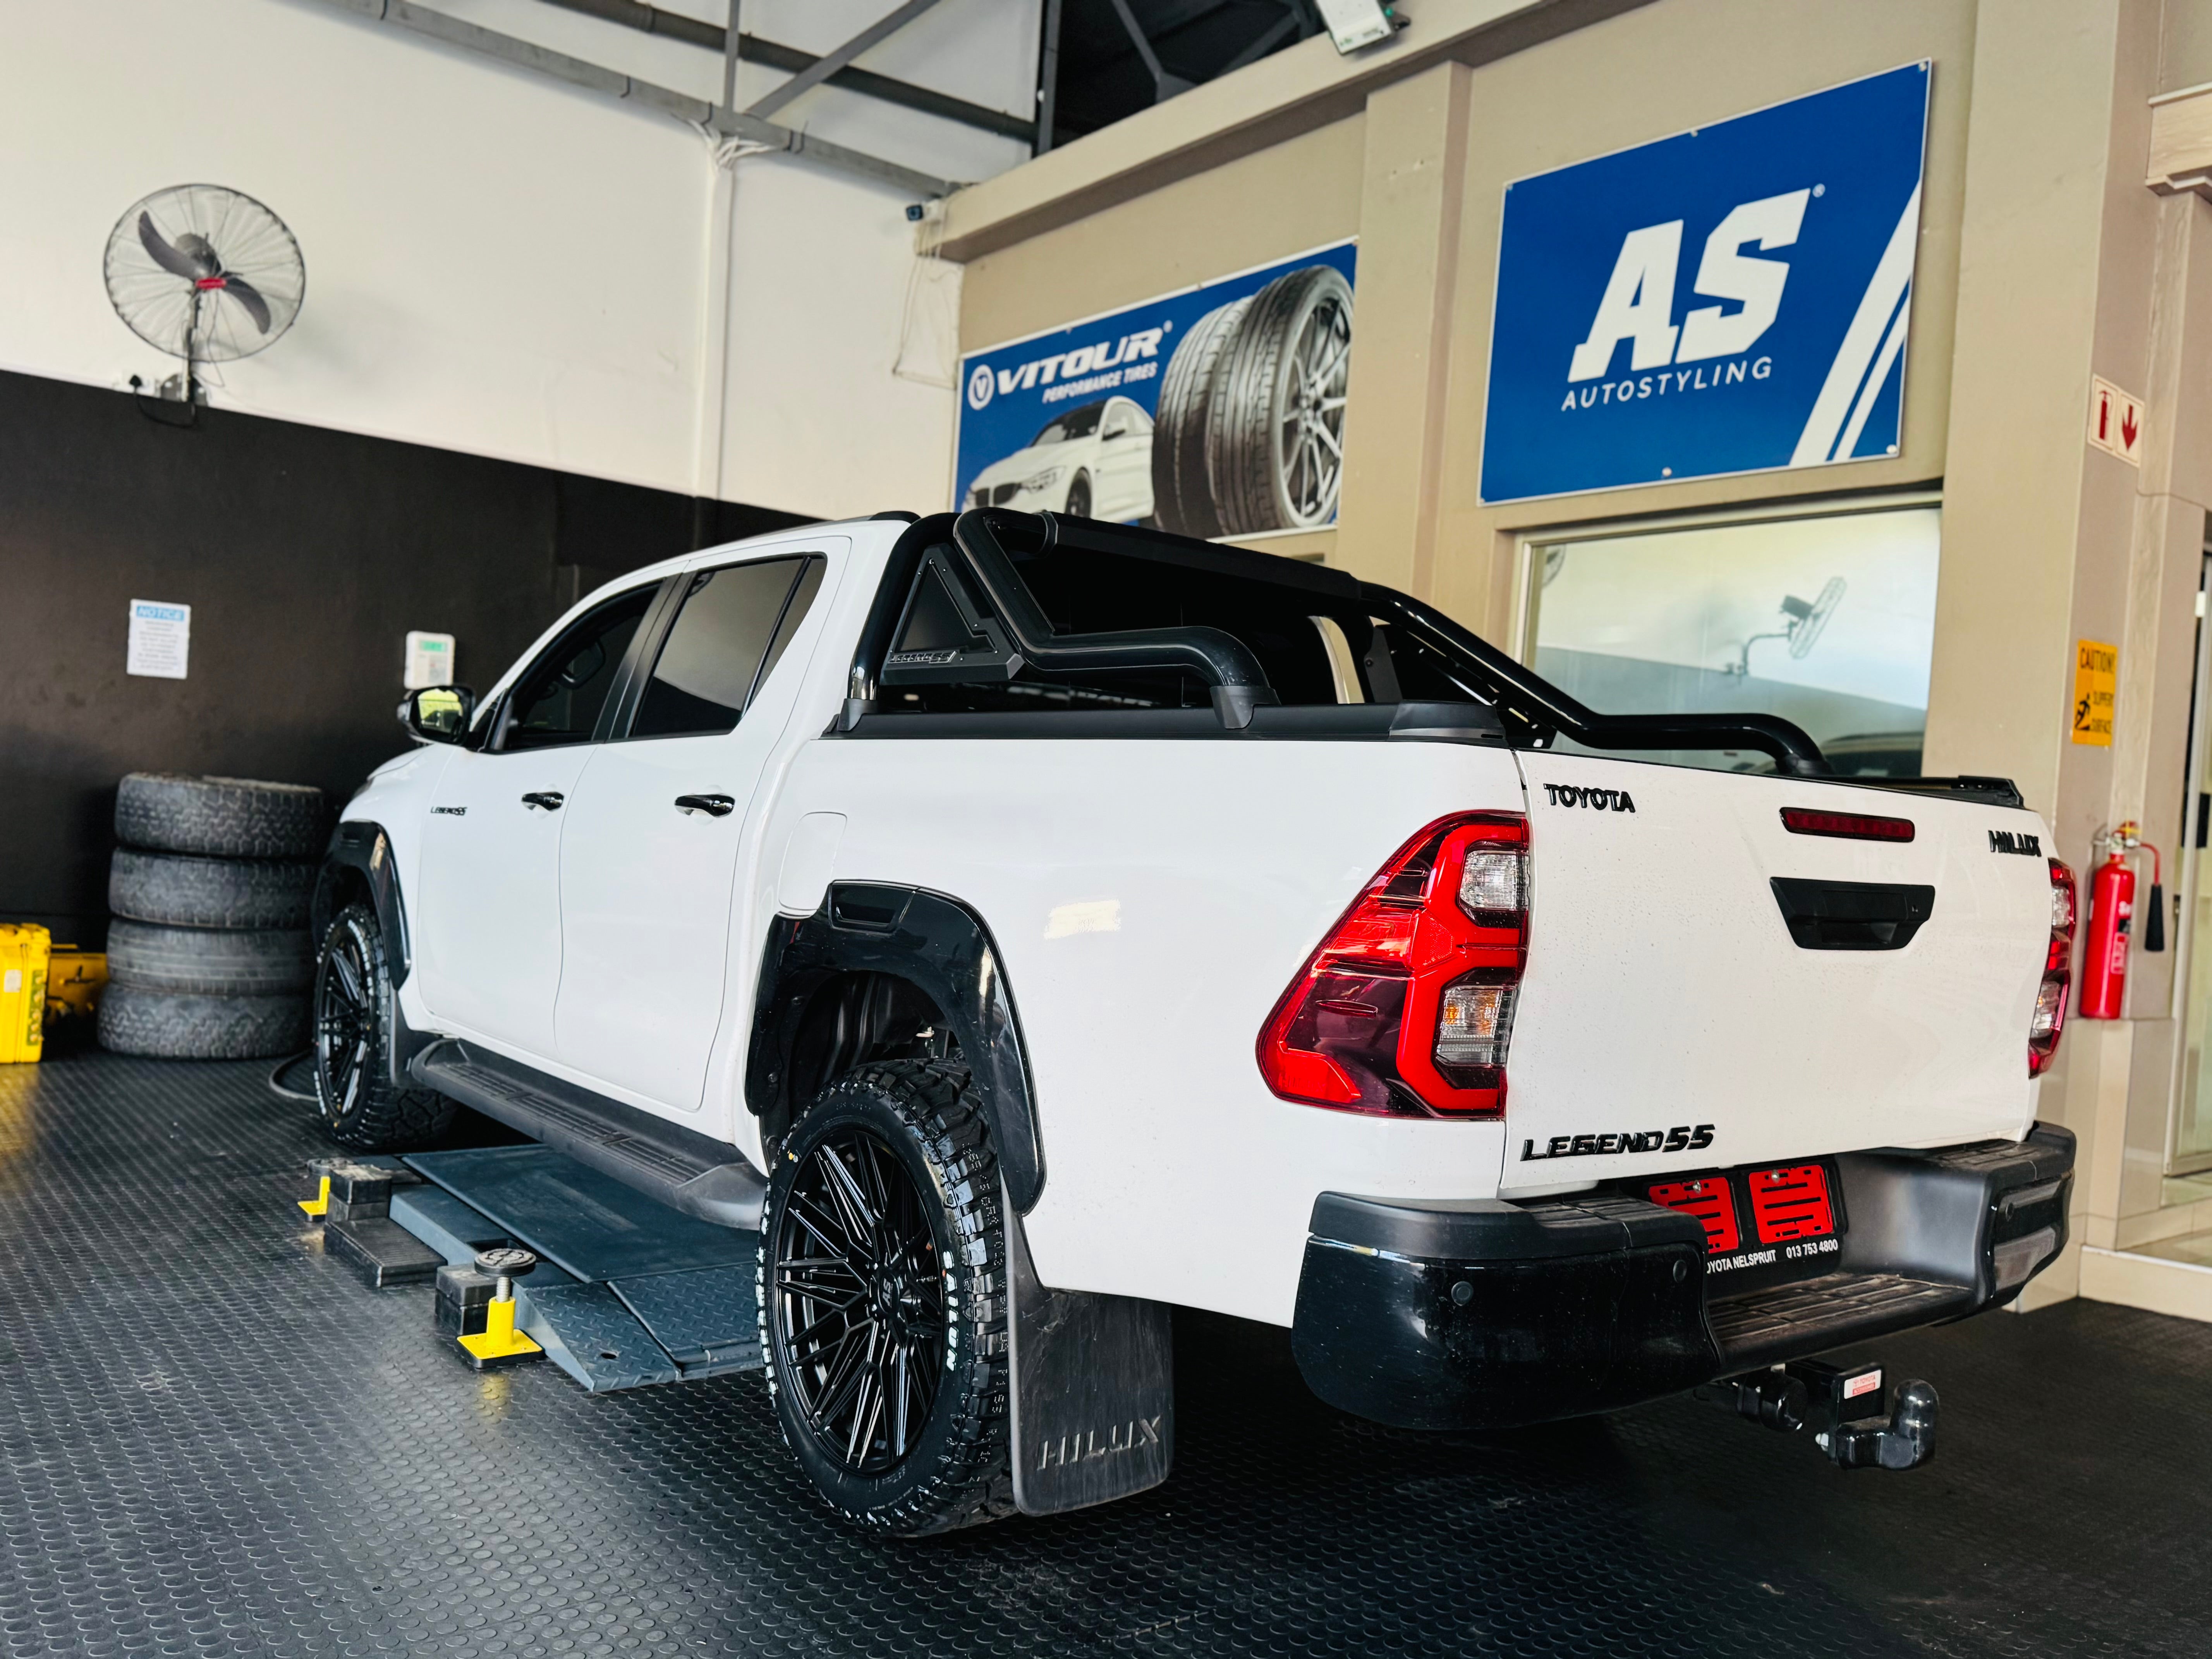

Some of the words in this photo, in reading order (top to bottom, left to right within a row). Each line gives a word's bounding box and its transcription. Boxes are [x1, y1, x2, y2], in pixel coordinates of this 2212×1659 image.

[1568, 188, 1811, 383] AS
[997, 327, 1163, 395] VITOUR
[1042, 371, 1123, 404] PERFORMANCE
[1123, 361, 1159, 385] TIRES
[1561, 356, 1772, 412] AUTOSTYLING
[138, 607, 182, 620] NOTICE
[1543, 783, 1636, 813] TOYOTA
[1988, 830, 2042, 857] HILUX
[1733, 1249, 1776, 1269] NELSPRUIT
[1786, 1245, 1802, 1259] 013
[1802, 1242, 1818, 1255] 753
[1819, 1238, 1838, 1252] 4800
[943, 1251, 958, 1372] SAILUN
[1037, 1415, 1161, 1471] HILUX
